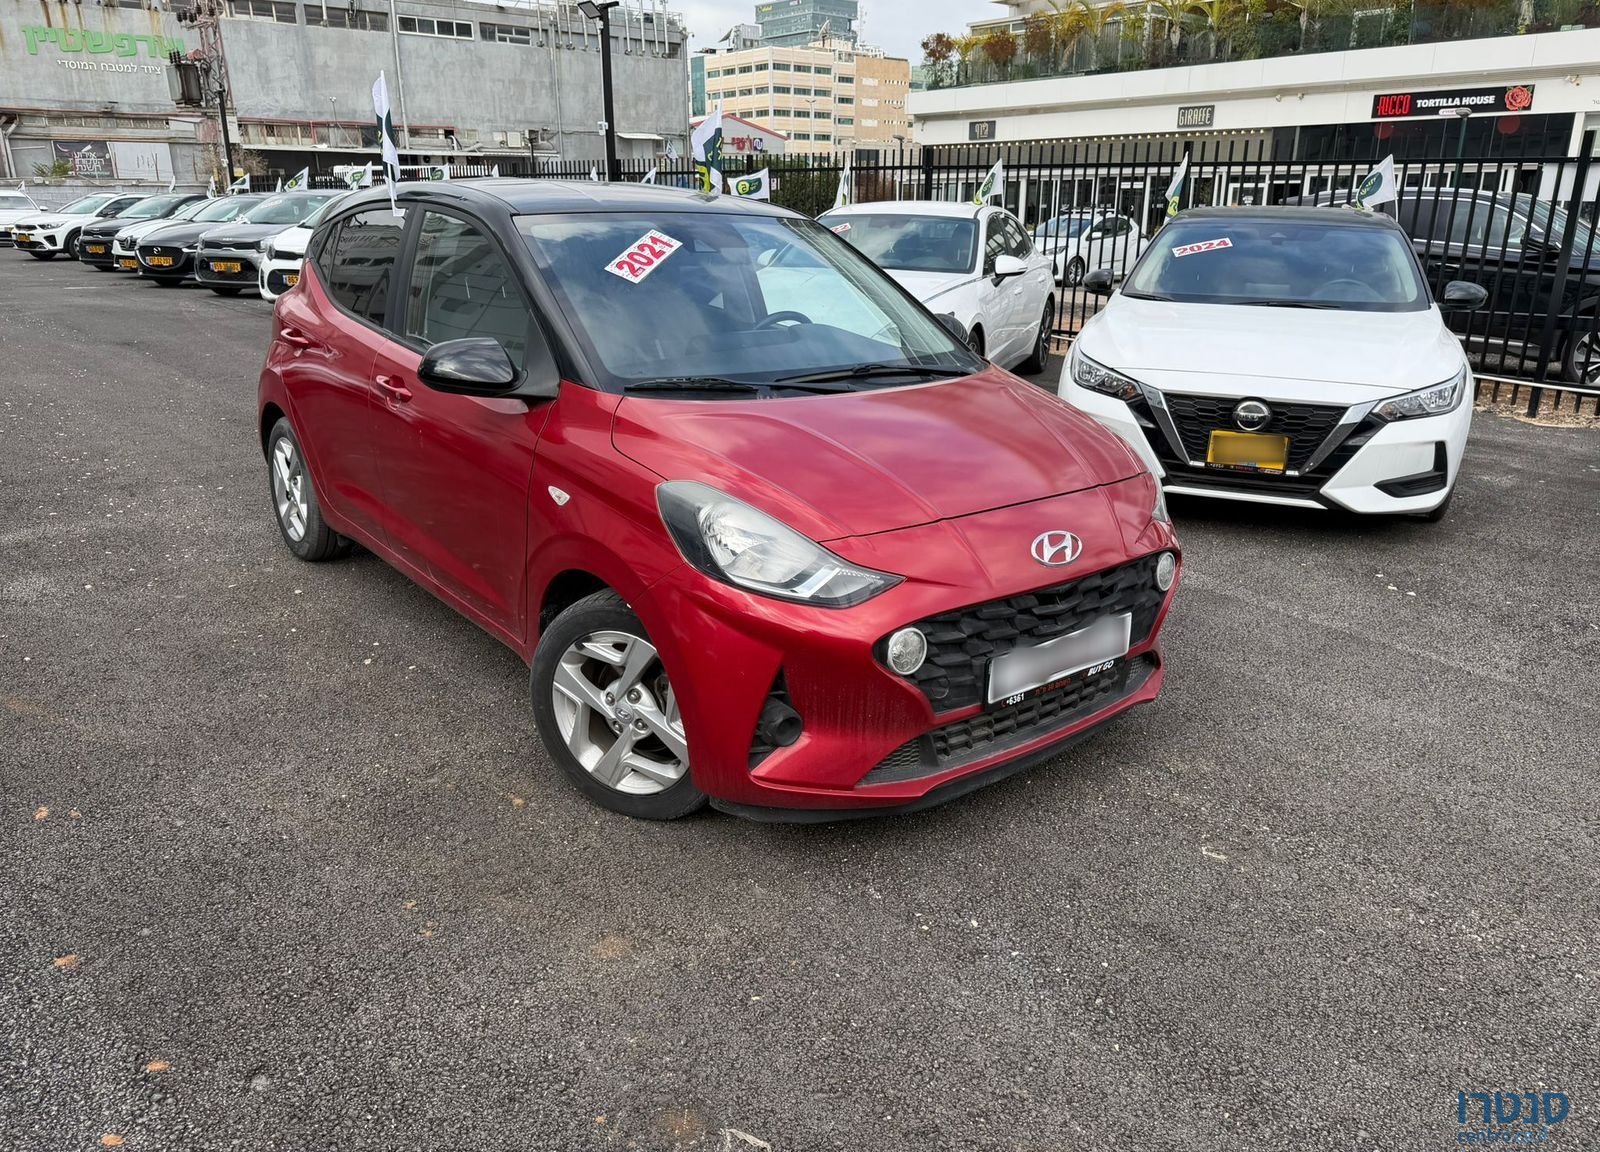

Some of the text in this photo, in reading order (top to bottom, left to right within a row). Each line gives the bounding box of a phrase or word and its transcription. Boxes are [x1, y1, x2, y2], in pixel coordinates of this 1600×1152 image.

[57, 59, 161, 75] ציוד למטבח המוסדי
[1416, 96, 1460, 108] TORTILLA
[1462, 95, 1495, 106] HOUSE
[1179, 107, 1212, 126] GIRAFFE
[1176, 240, 1230, 256] 2024
[615, 235, 674, 278] 2021
[1087, 660, 1115, 677] BUY GO
